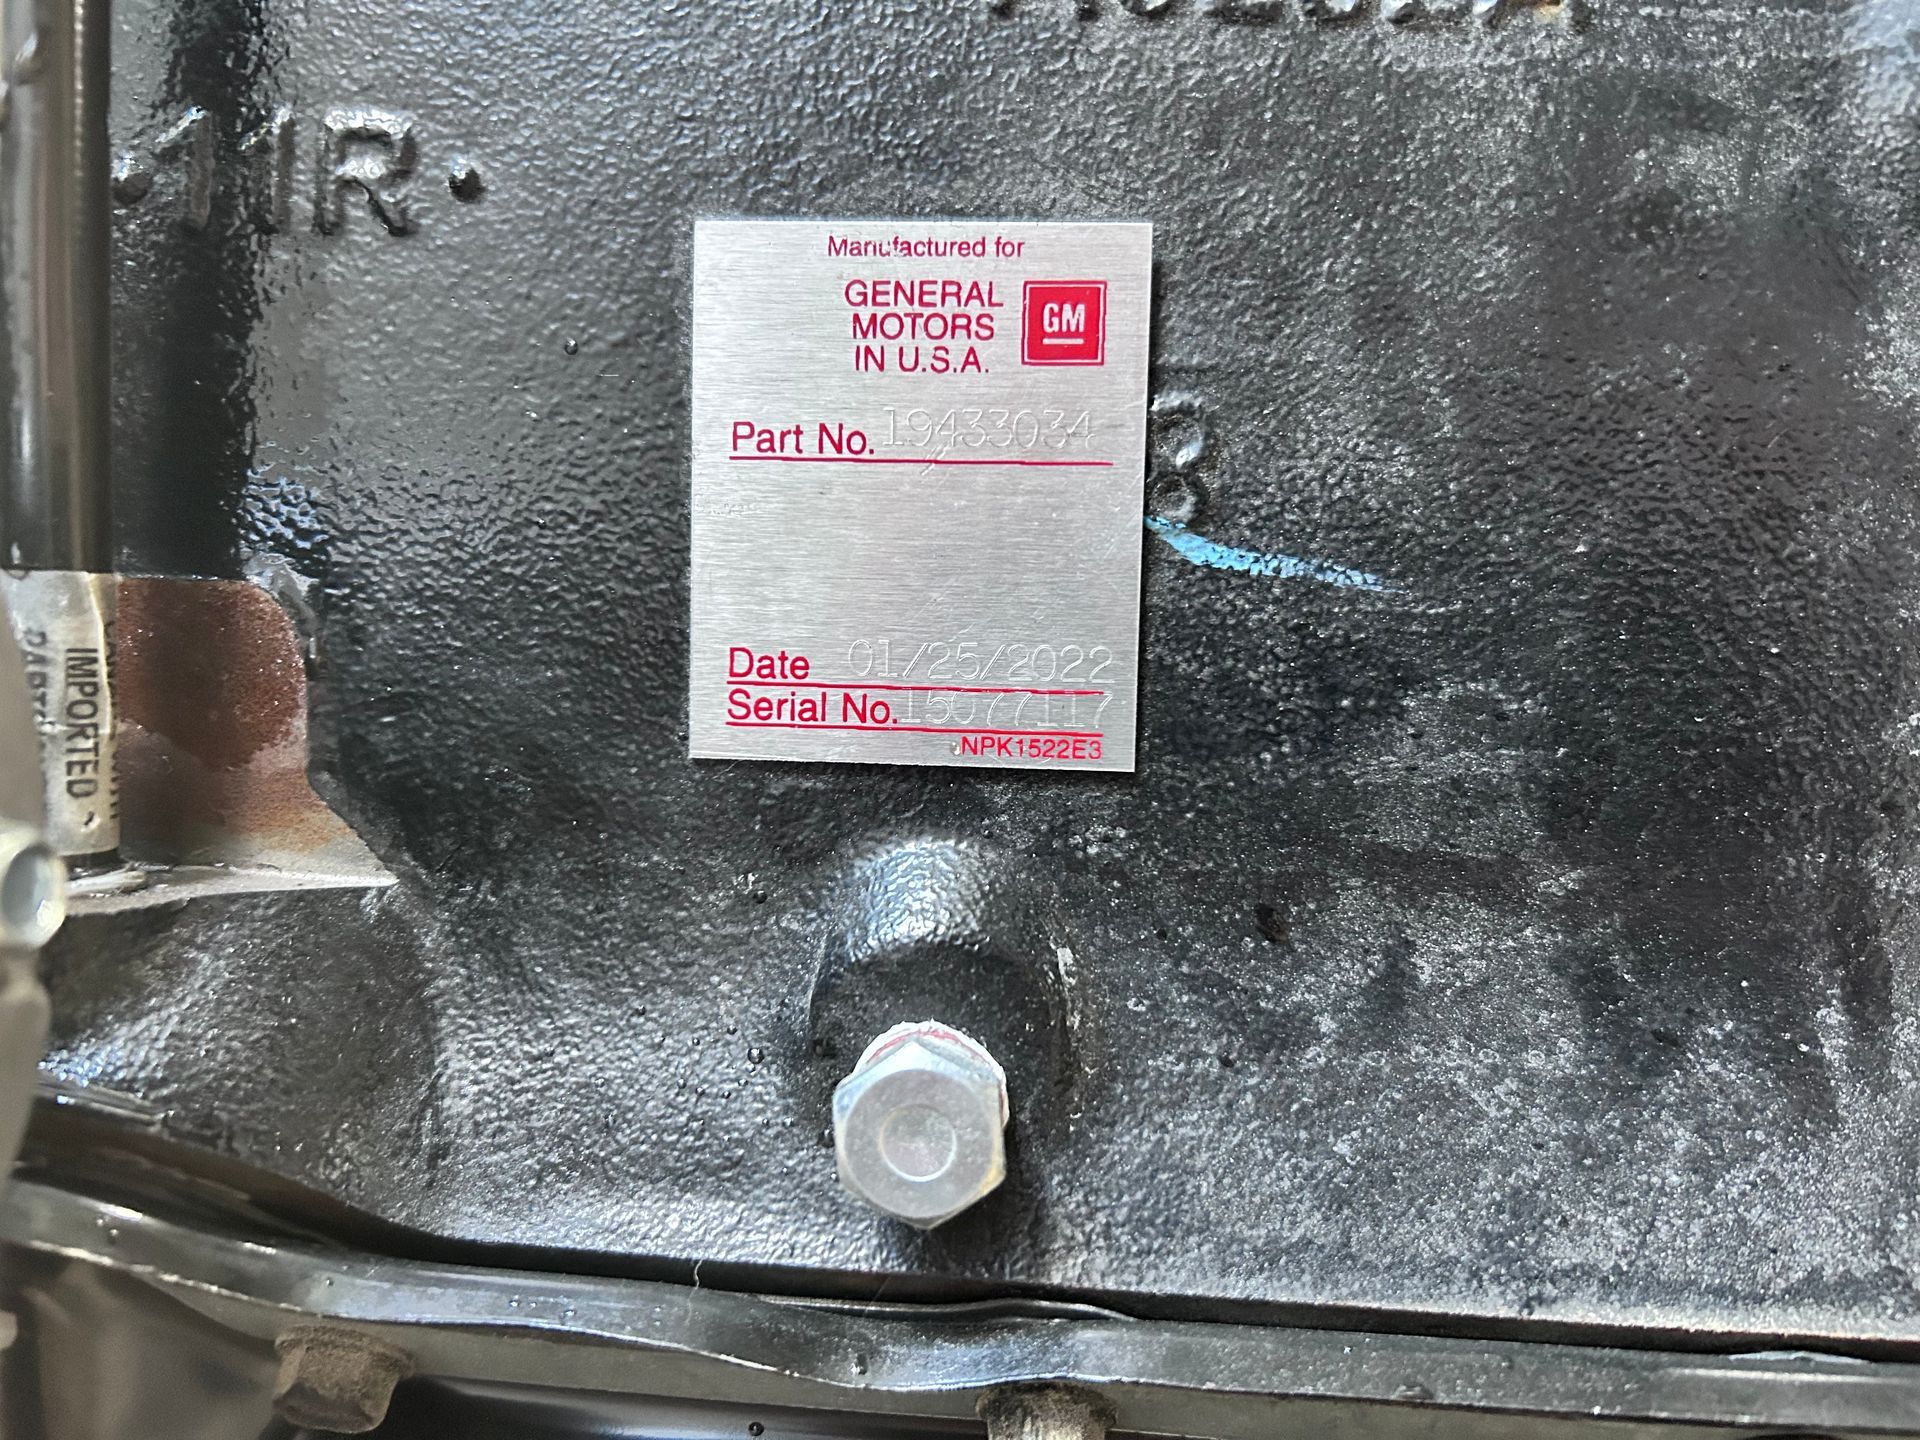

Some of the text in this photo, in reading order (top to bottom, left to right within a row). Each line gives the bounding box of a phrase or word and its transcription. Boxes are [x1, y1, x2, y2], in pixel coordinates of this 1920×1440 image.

[828, 236, 1025, 258] Manufactured for
[845, 280, 1004, 308] GENERAL
[852, 313, 995, 341] MOTORS
[1042, 303, 1086, 333] GM
[855, 346, 990, 374] IN U.S.A.
[732, 406, 1097, 456] Part No. 19433034
[729, 638, 1115, 683] Date 01/25/2022
[727, 688, 1113, 729] Serial No. 15077117
[65, 648, 100, 799] IMPORTED
[961, 736, 1102, 761] NPK1522E3
